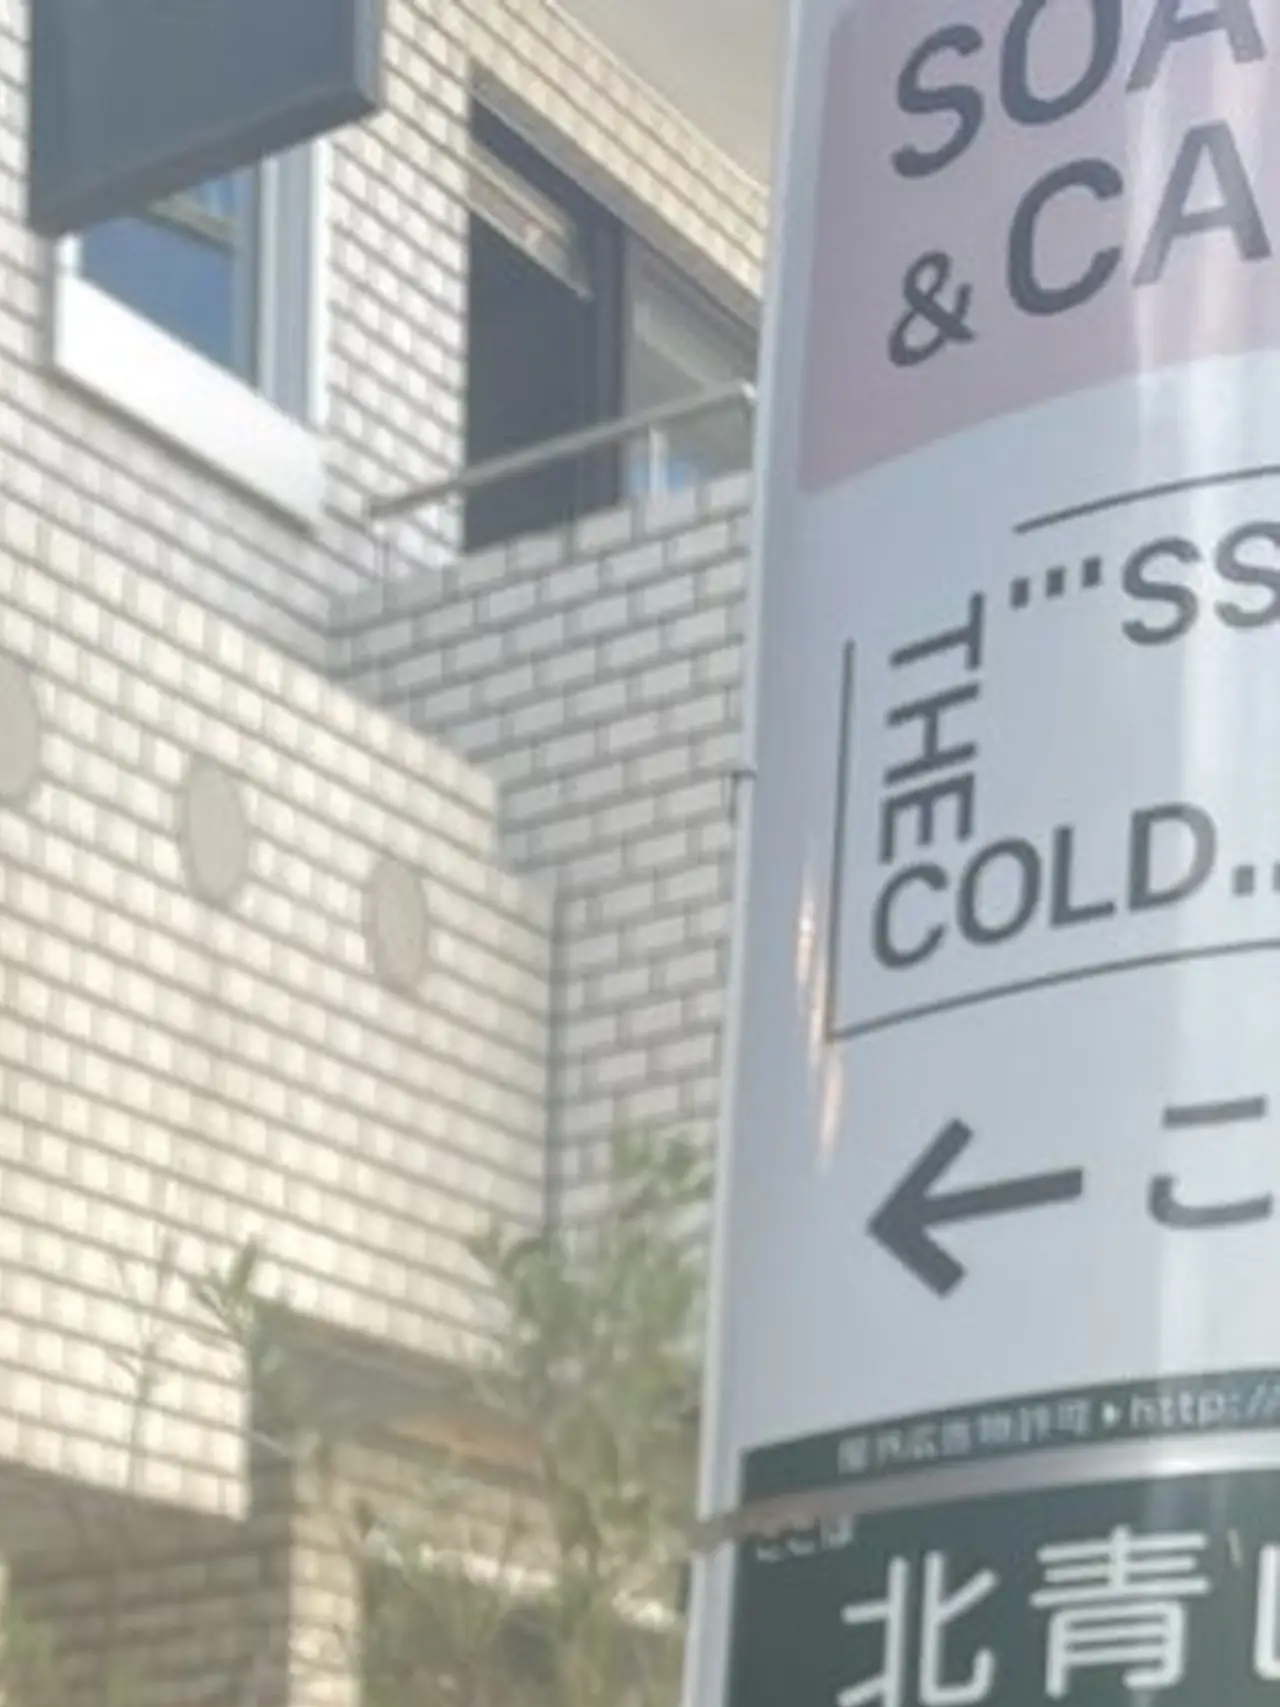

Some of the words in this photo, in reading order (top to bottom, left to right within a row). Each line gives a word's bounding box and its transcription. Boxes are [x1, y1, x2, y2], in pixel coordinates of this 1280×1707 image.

[887, 251, 975, 367] &
[1007, 118, 1272, 317] CA
[880, 593, 985, 864] THE
